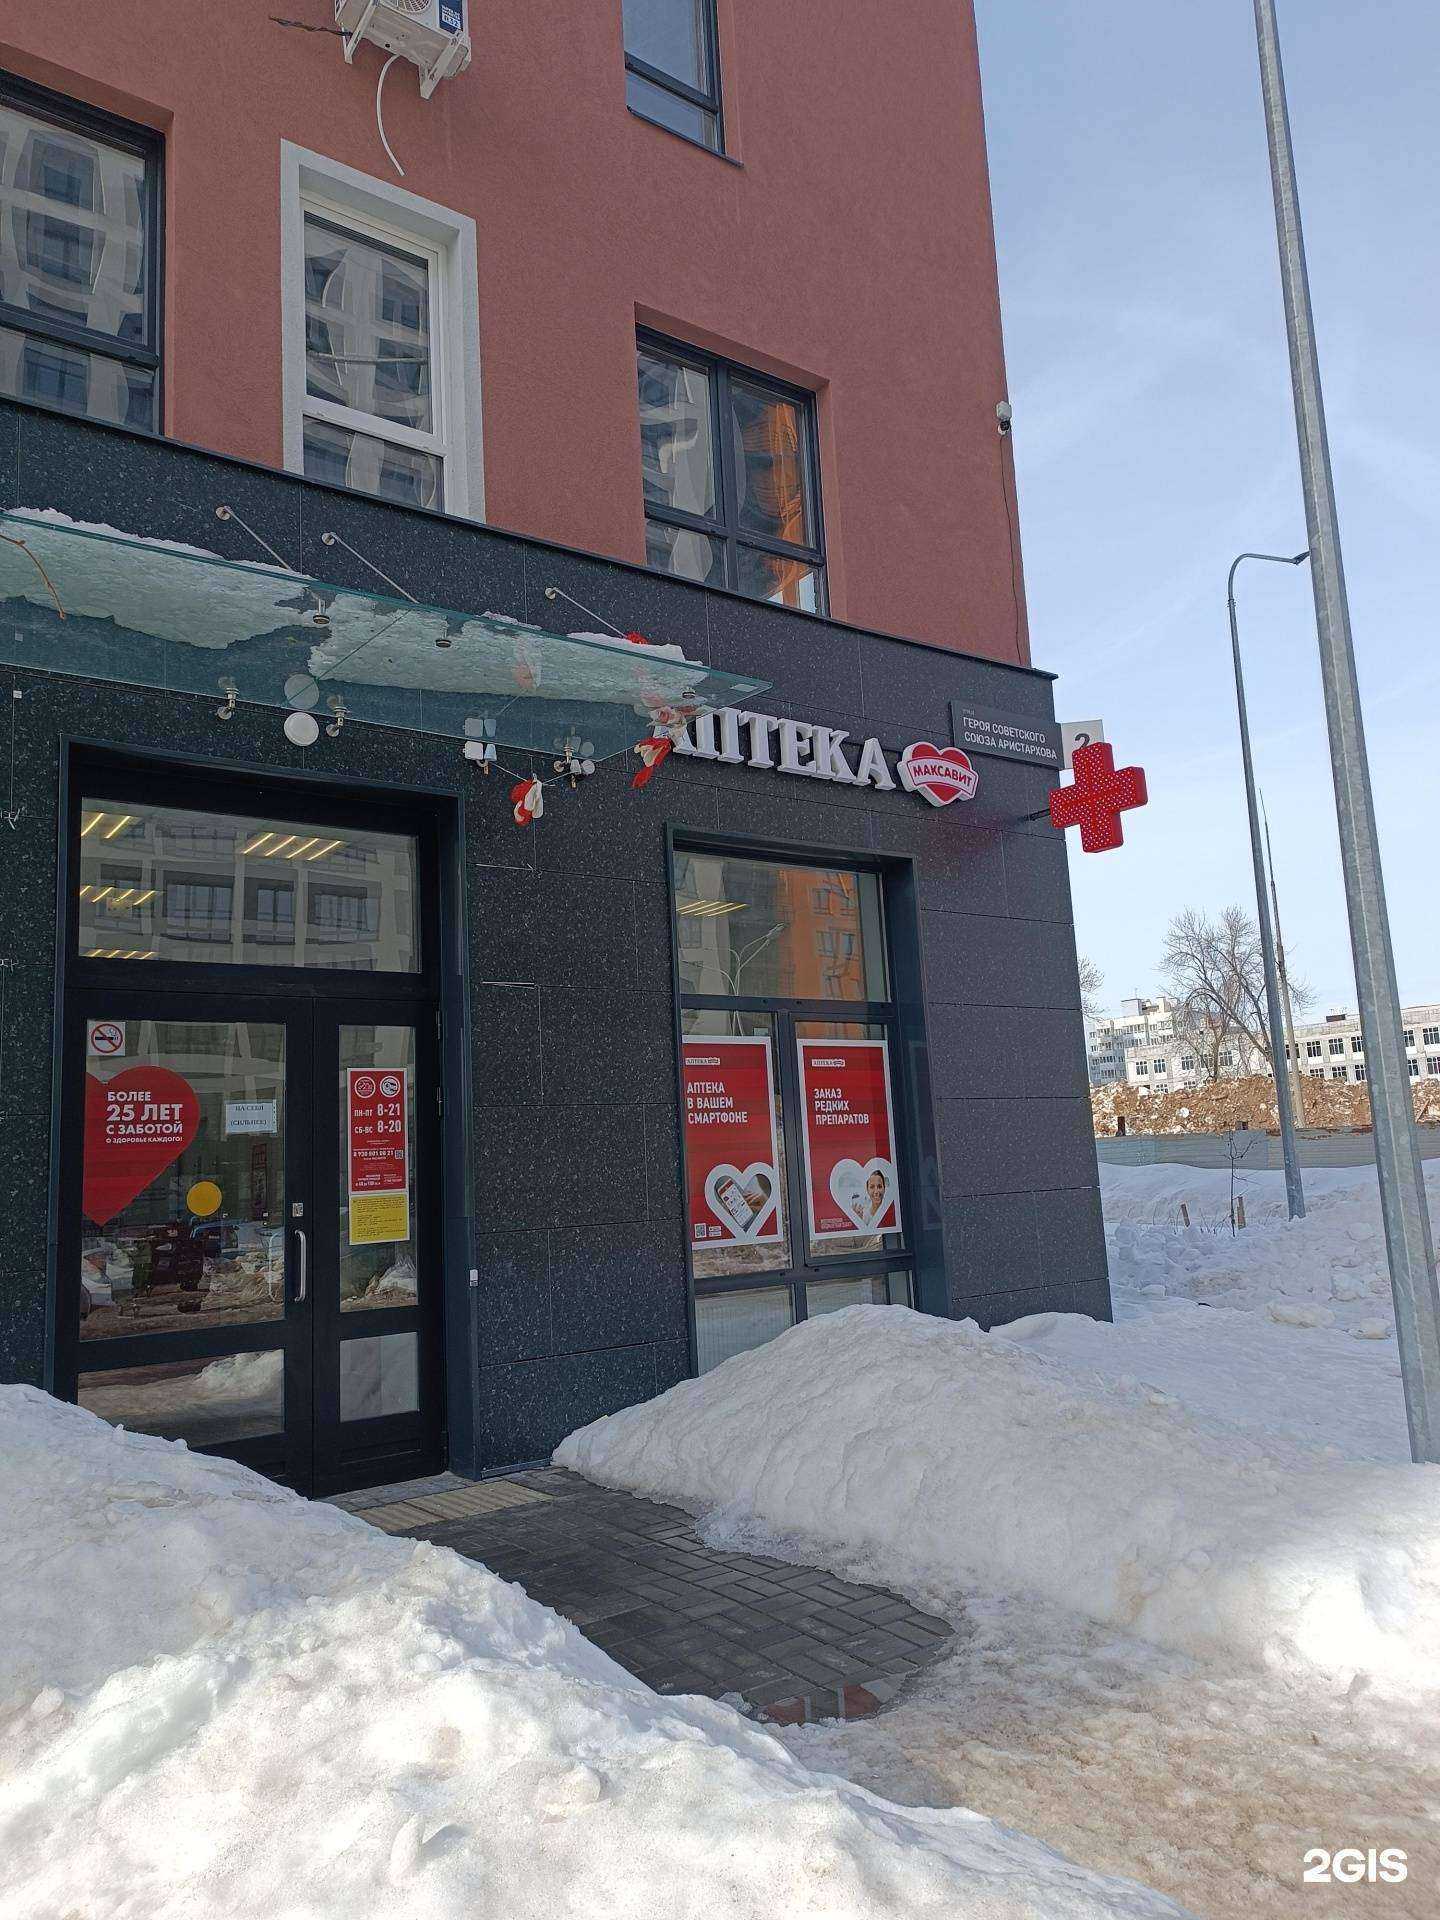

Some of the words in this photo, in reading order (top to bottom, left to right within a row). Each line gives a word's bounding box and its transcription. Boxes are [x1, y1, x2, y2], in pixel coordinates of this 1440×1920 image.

[963, 716, 991, 731] ГЕРОЯ
[992, 723, 1046, 743] СОВЕТСКОГО
[964, 731, 997, 748] СОЮЗА
[998, 738, 1058, 760] АРИСТАРХОВА
[912, 764, 973, 787] МАКСАВИТ
[686, 1081, 726, 1094] АПТЕКА
[814, 1088, 842, 1099] ЗАКАЗ
[107, 1091, 152, 1102] БОЛЕЕ
[687, 1098, 694, 1109] В
[697, 1096, 734, 1109] ВАШЕМ
[106, 1103, 135, 1122] 25
[141, 1103, 184, 1121] ЛЕТ
[354, 1109, 374, 1117] ПН-ПТ
[377, 1102, 401, 1116] 8-21
[814, 1100, 850, 1113] РЕДКИХ
[688, 1111, 749, 1125] СМАРТФОНЕ
[815, 1113, 870, 1125] ПРЕПАРАТОВ
[106, 1125, 115, 1135] С
[118, 1120, 183, 1135] ЗАБОТОЙ
[377, 1119, 402, 1133] 8-20
